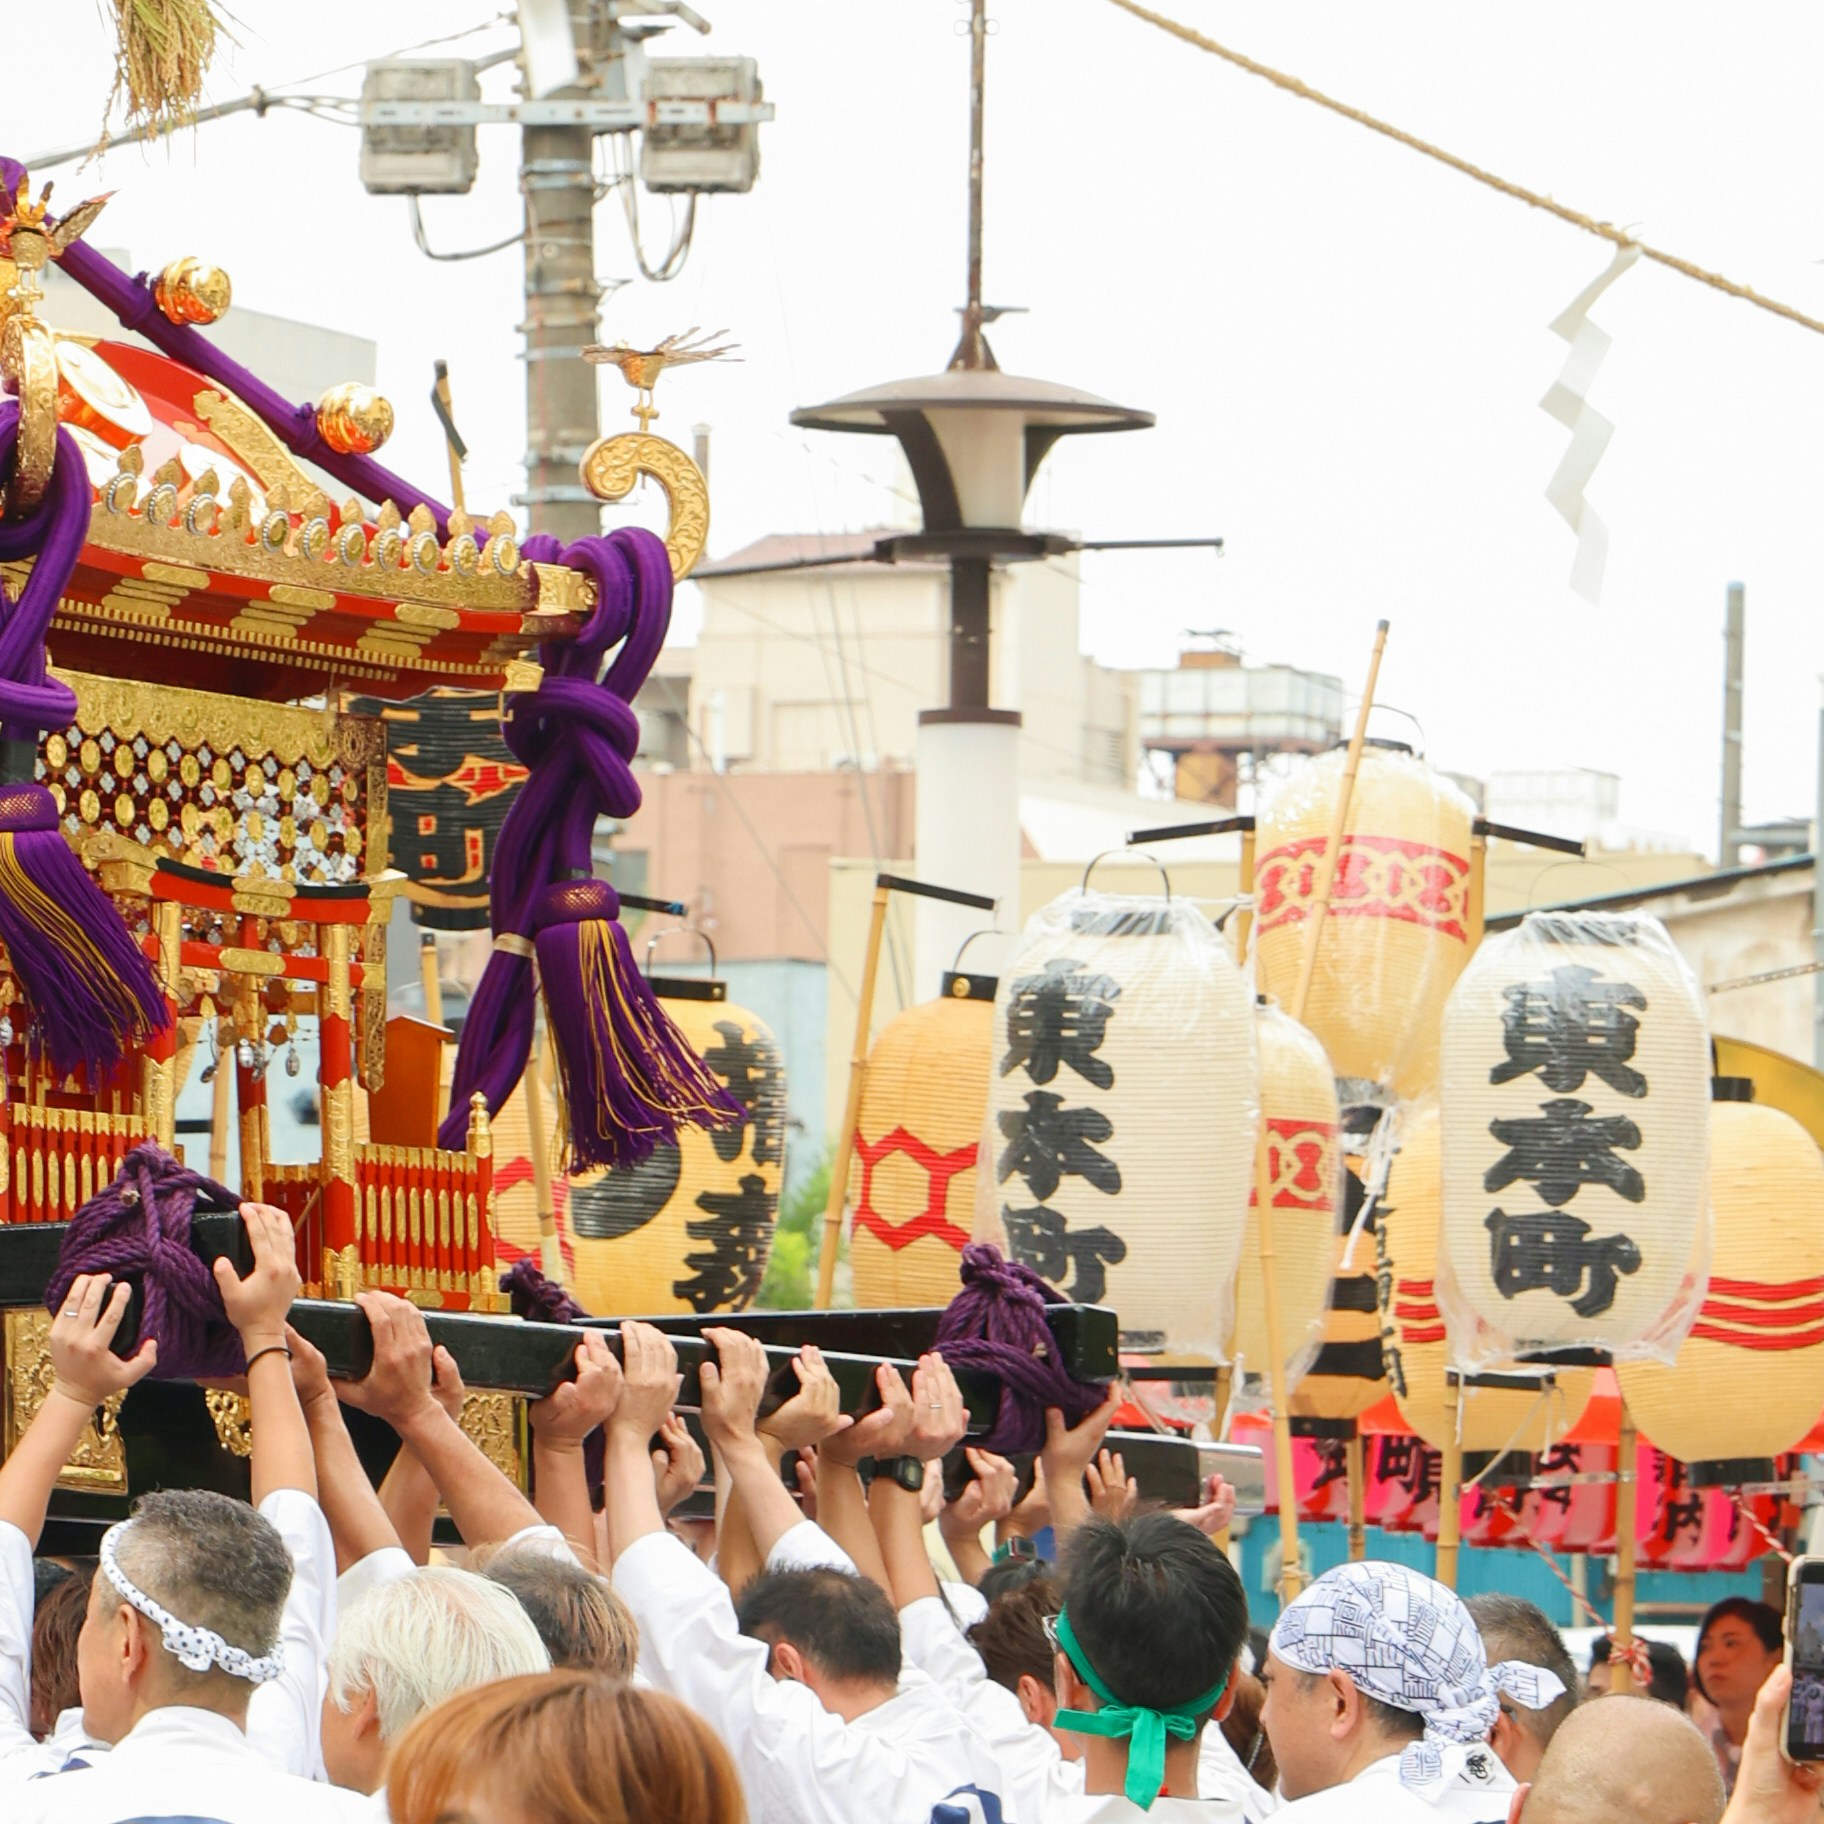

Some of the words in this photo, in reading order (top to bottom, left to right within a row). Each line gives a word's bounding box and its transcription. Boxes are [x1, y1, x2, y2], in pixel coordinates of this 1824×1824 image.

[998, 957, 1128, 1305] 東本町
[1482, 963, 1648, 1319] 東本町
